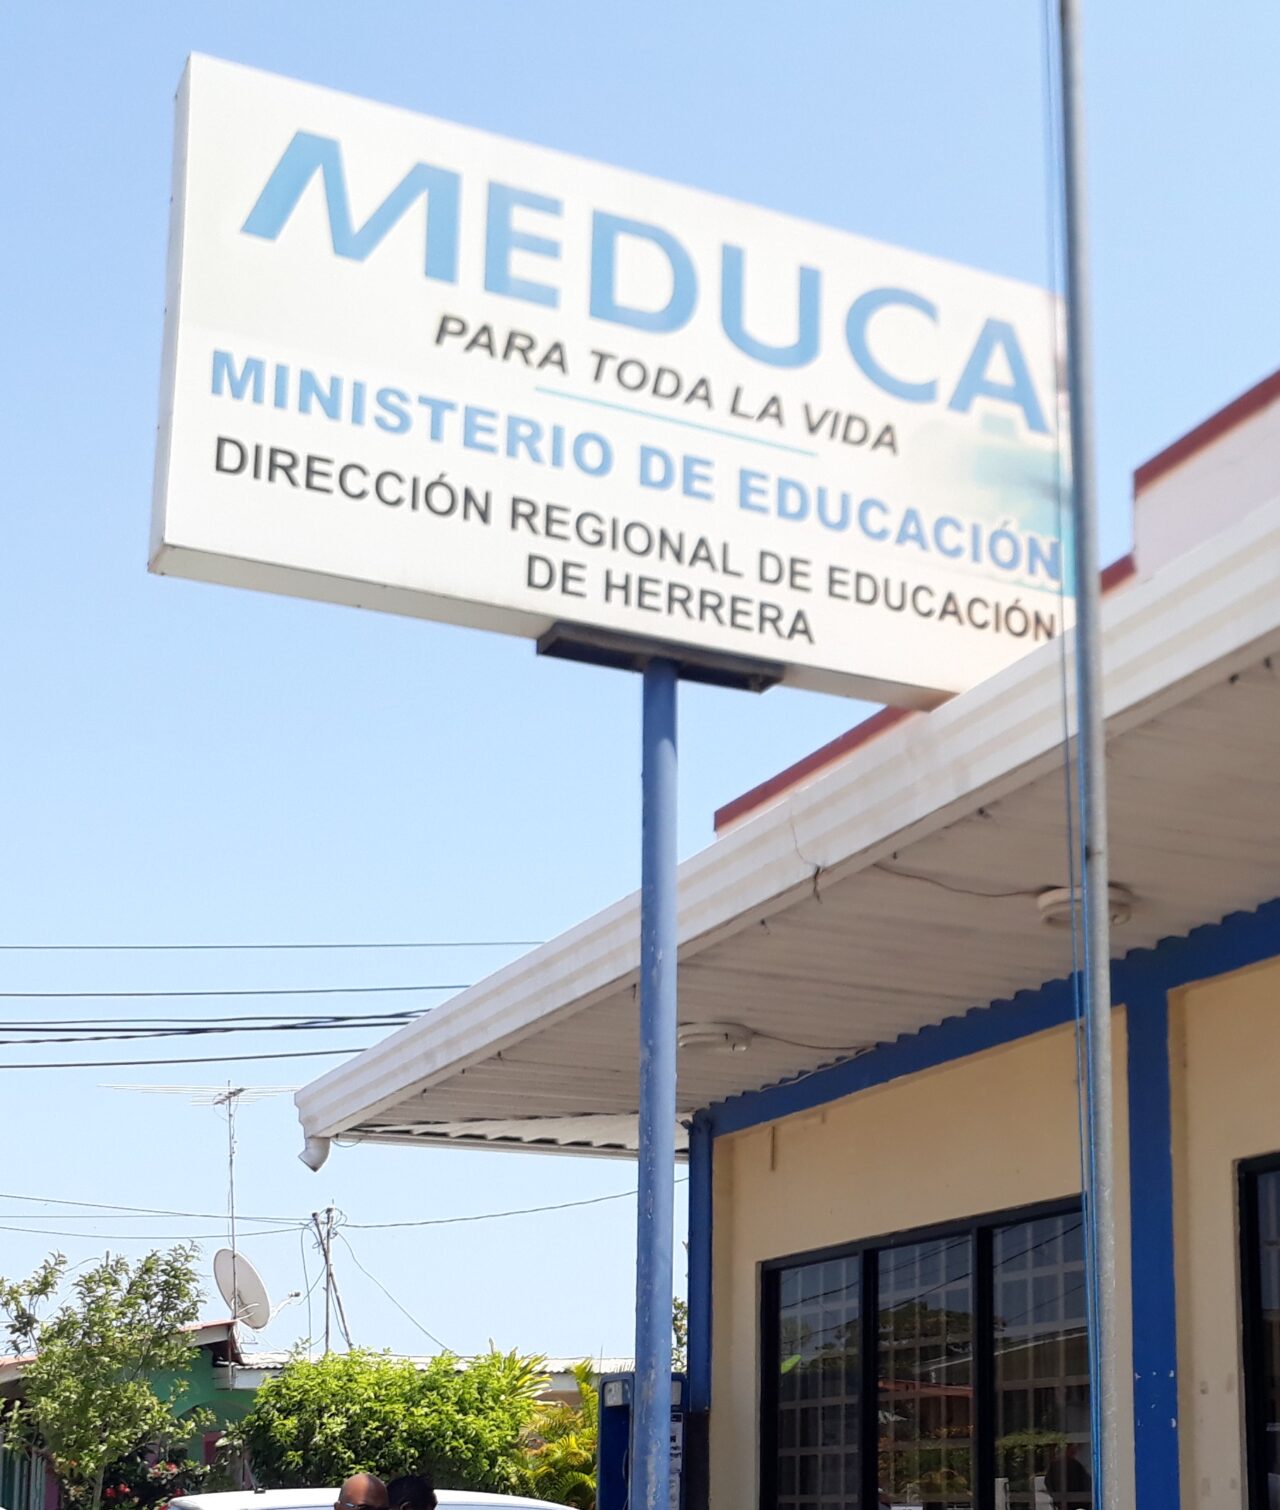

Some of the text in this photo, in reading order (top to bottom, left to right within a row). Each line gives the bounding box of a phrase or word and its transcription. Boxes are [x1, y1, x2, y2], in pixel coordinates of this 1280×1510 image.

[240, 129, 1051, 436] MEDUCA
[434, 314, 899, 457] PARA TODA LA VIDA
[211, 349, 1061, 582] MINISTERIO DE EDUCACIÓN
[214, 436, 1056, 642] DIRECCIÓN REGIONAL DE EDUCACIÓN
[526, 553, 816, 646] DE HERRERA
